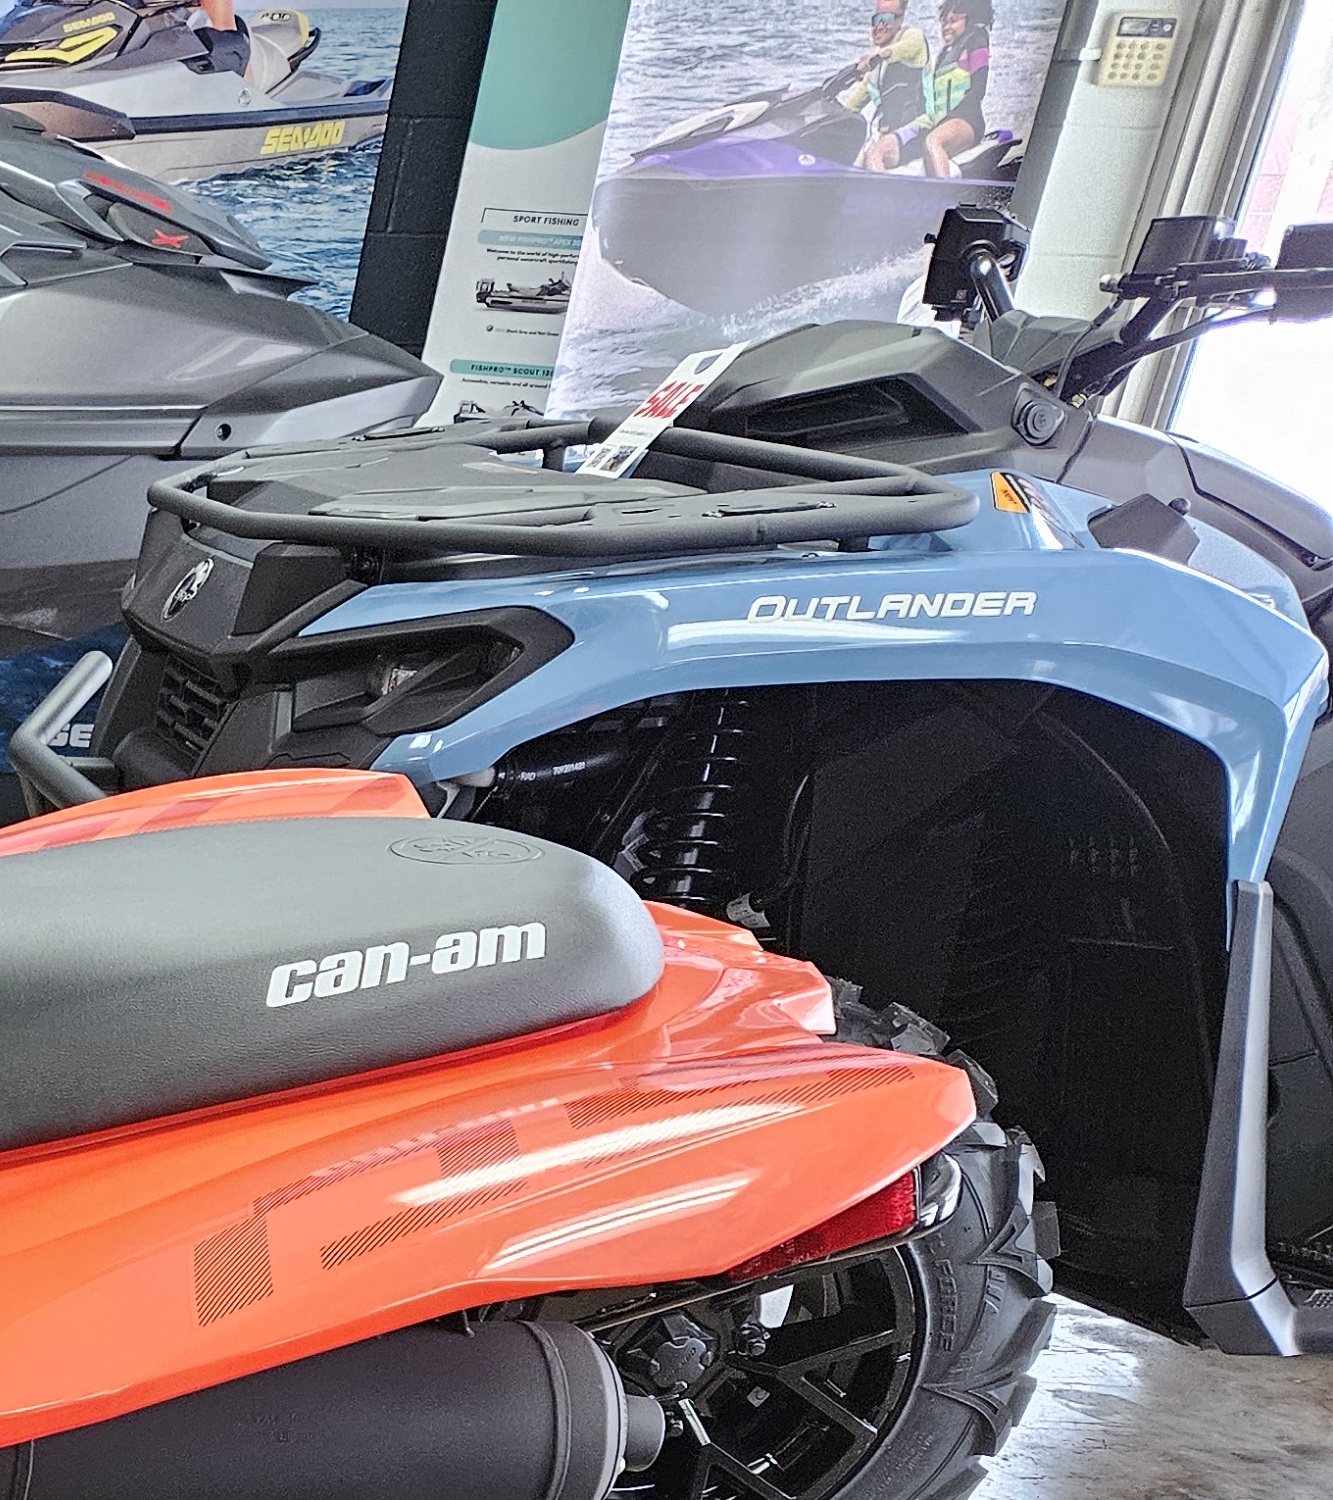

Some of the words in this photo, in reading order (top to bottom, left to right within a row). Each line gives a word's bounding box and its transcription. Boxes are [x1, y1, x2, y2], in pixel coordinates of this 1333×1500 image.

[513, 215, 542, 224] SPORT
[544, 217, 579, 227] FISHING
[513, 367, 539, 376] SCOUT
[633, 380, 705, 420] SALE
[747, 591, 1037, 624] OUTLANDER
[266, 922, 547, 1008] can-am
